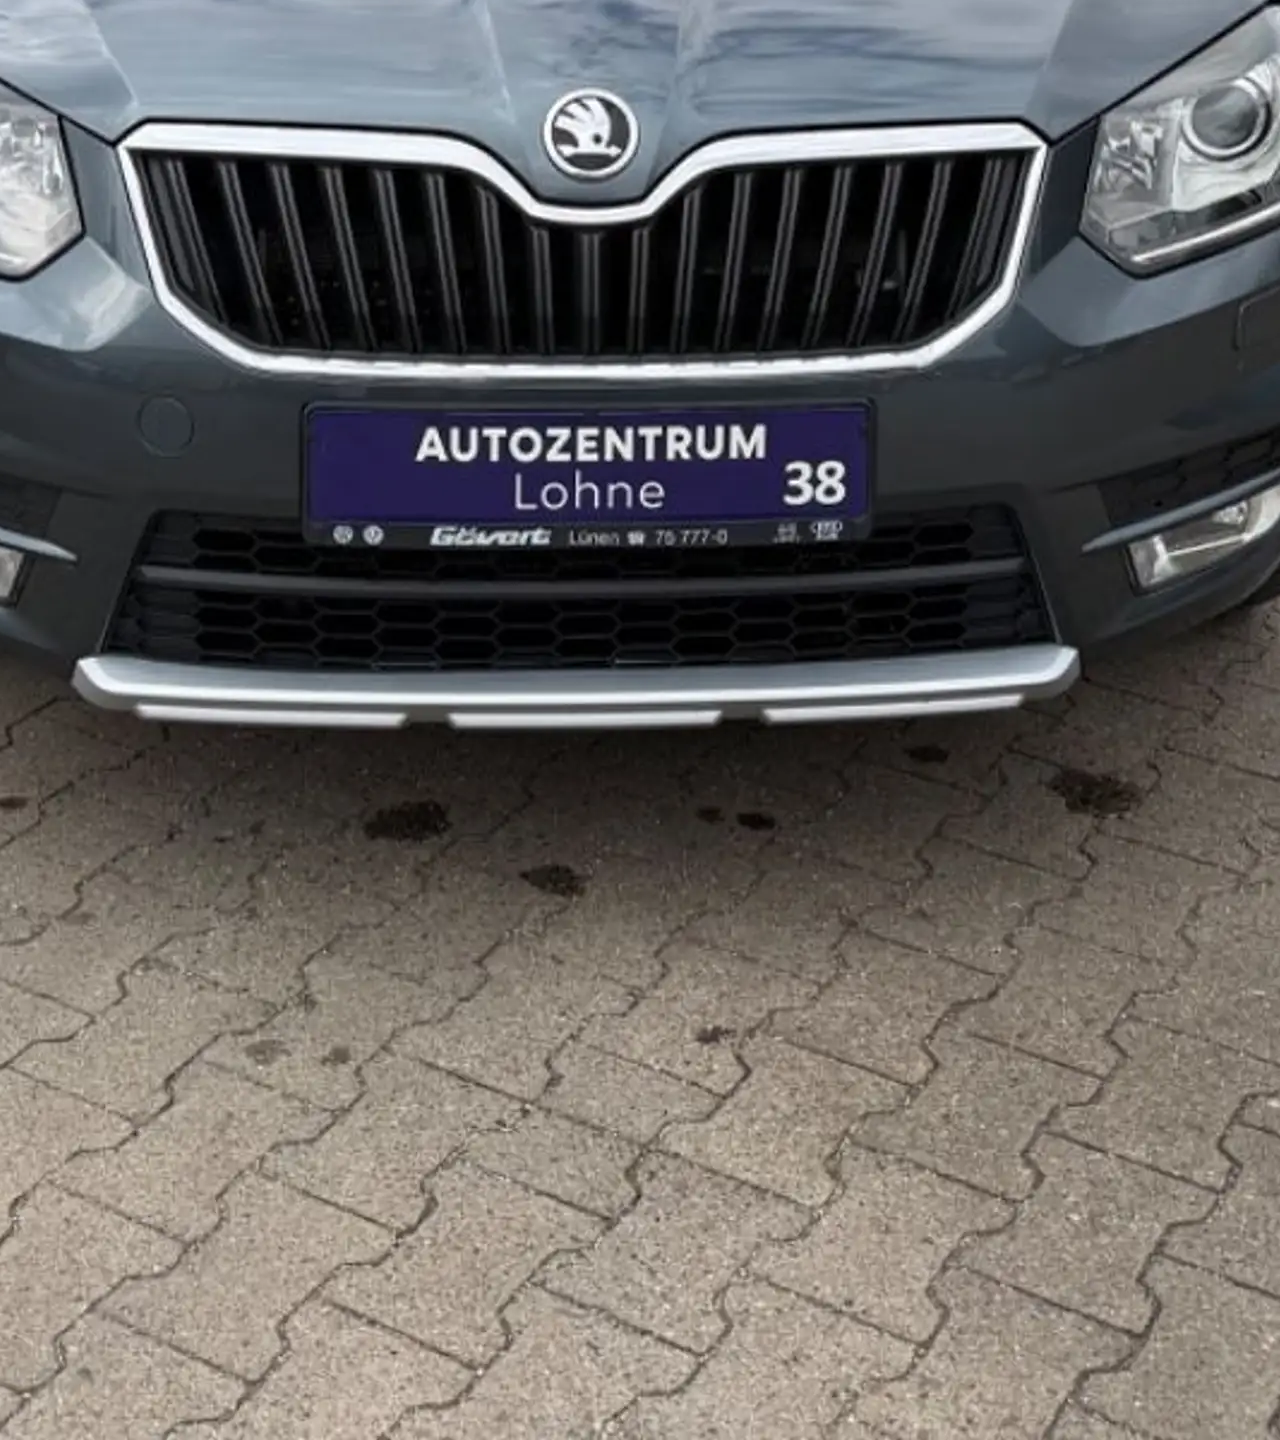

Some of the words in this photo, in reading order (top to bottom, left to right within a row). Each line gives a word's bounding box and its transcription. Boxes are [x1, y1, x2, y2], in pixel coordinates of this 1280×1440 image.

[415, 424, 768, 463] AUTOZENTRUM
[514, 469, 666, 511] Lohne
[782, 460, 848, 507] 38
